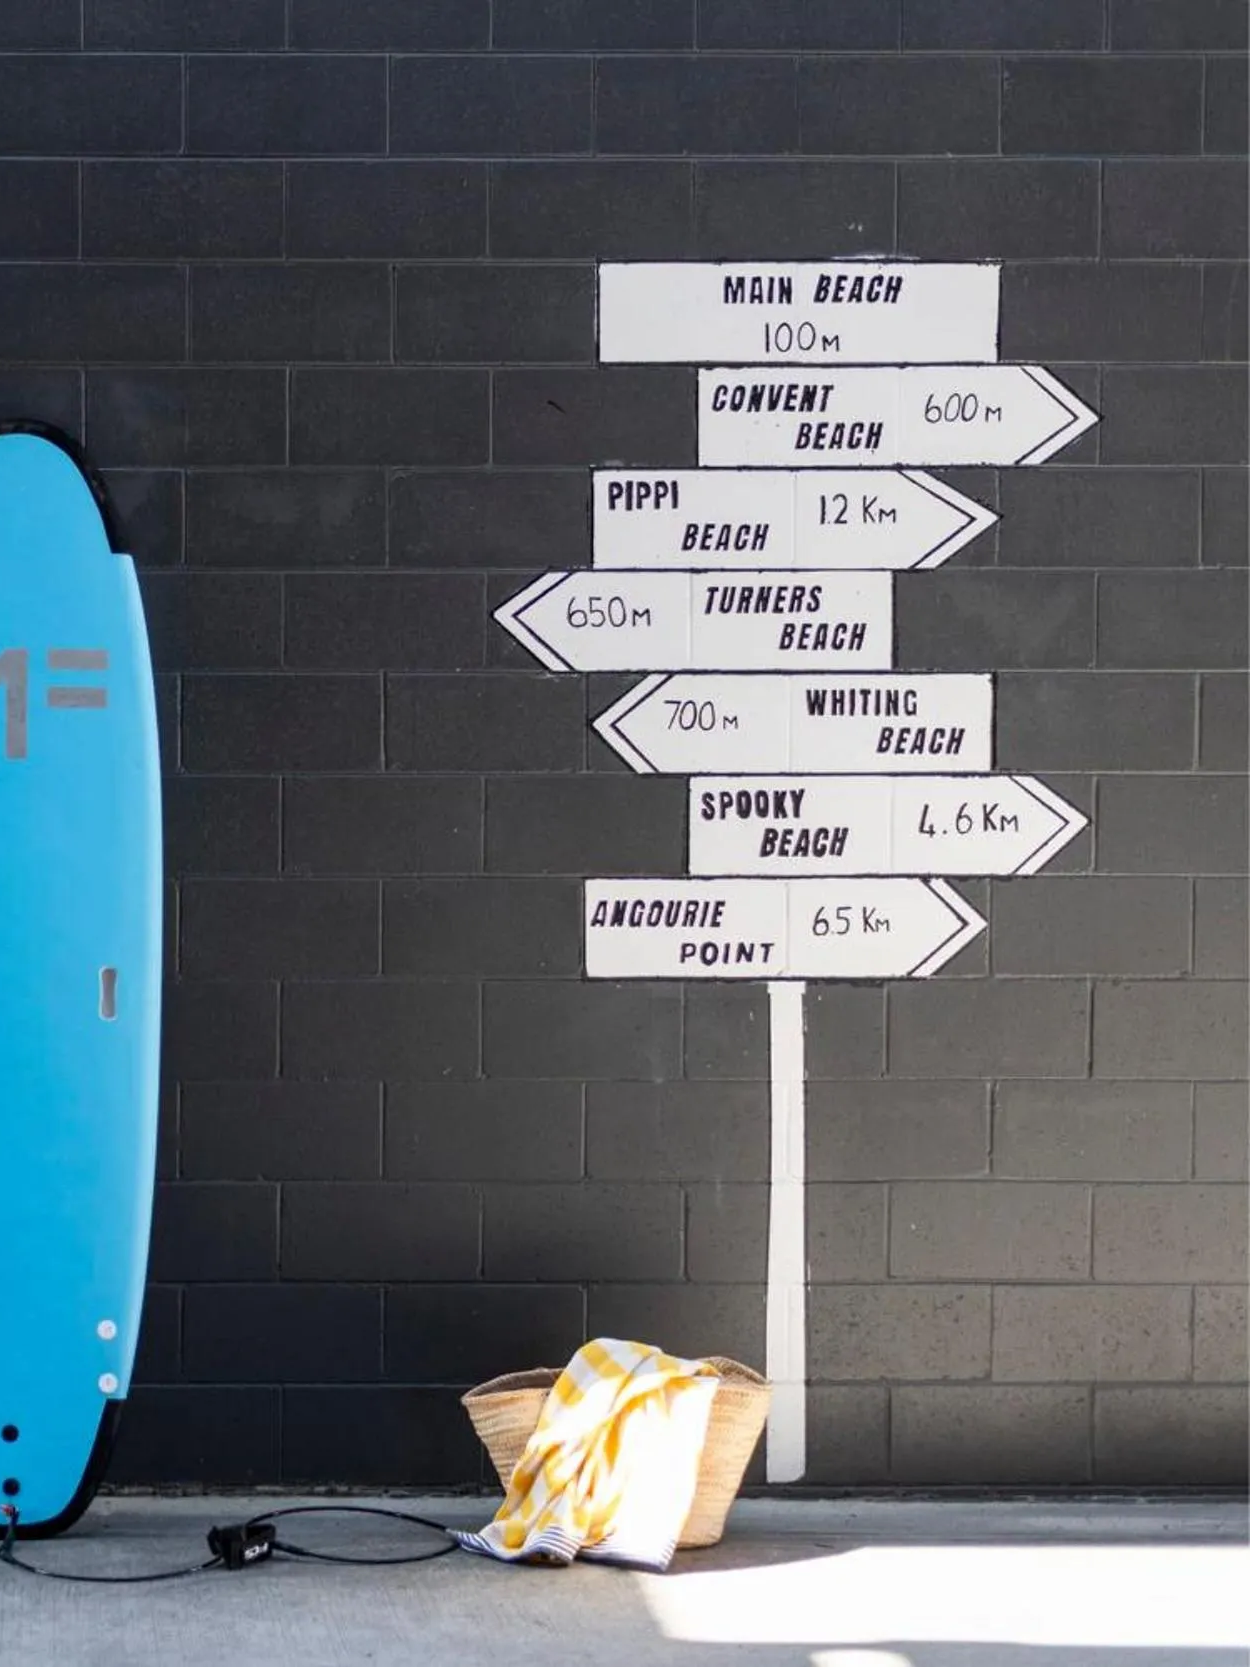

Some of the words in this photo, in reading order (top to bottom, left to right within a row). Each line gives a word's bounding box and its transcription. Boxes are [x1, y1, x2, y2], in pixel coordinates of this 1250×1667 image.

[723, 275, 793, 305] MAIN
[813, 273, 903, 304] BEACH
[711, 383, 835, 413] CONVENT
[794, 421, 884, 451] BEACH
[608, 480, 679, 512] PIPPI
[681, 523, 770, 551] BEACH
[704, 585, 823, 615] TURNERS
[778, 622, 867, 651] BEACH
[806, 688, 917, 717] WHITING
[876, 726, 966, 755] BEACH
[701, 788, 805, 821] SPOOKY
[919, 802, 973, 837] 4.6
[759, 827, 849, 858] BEACH
[590, 899, 726, 928] ANGOURIE
[680, 941, 775, 967] POINT
